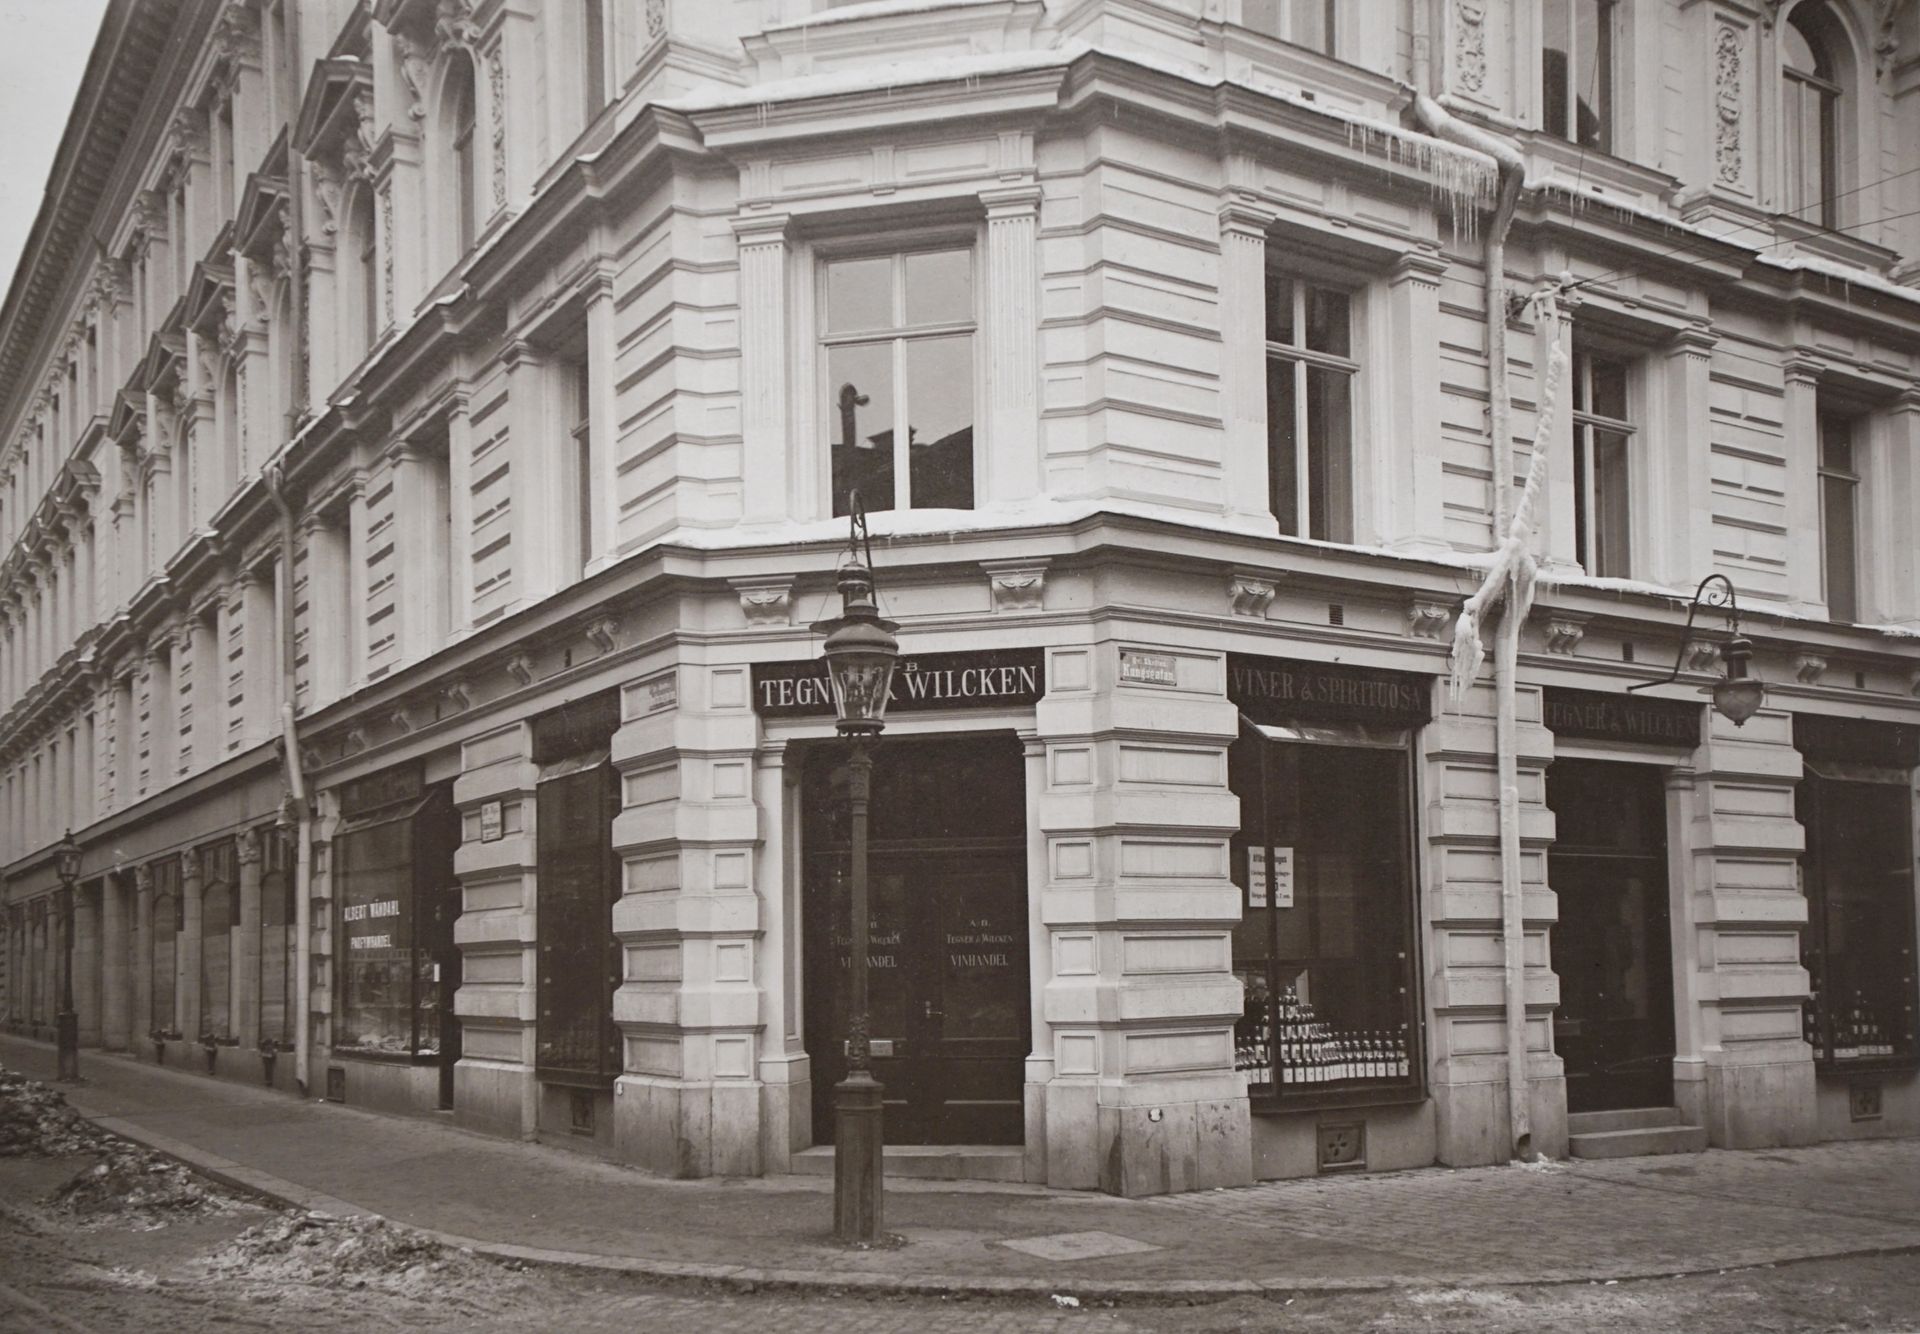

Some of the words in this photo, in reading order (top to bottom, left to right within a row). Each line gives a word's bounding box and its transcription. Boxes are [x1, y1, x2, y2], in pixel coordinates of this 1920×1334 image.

[760, 672, 867, 707] TEGN
[903, 665, 1037, 699] WILCKEN
[1232, 667, 1294, 699] VINER
[1301, 675, 1315, 702] &
[1317, 675, 1422, 711] SPIRITUOSA
[1624, 709, 1699, 738] WILCKEN
[344, 904, 367, 922] ALBERT
[841, 955, 897, 969] VIANDEL
[950, 954, 1009, 967] VINHANDEL
